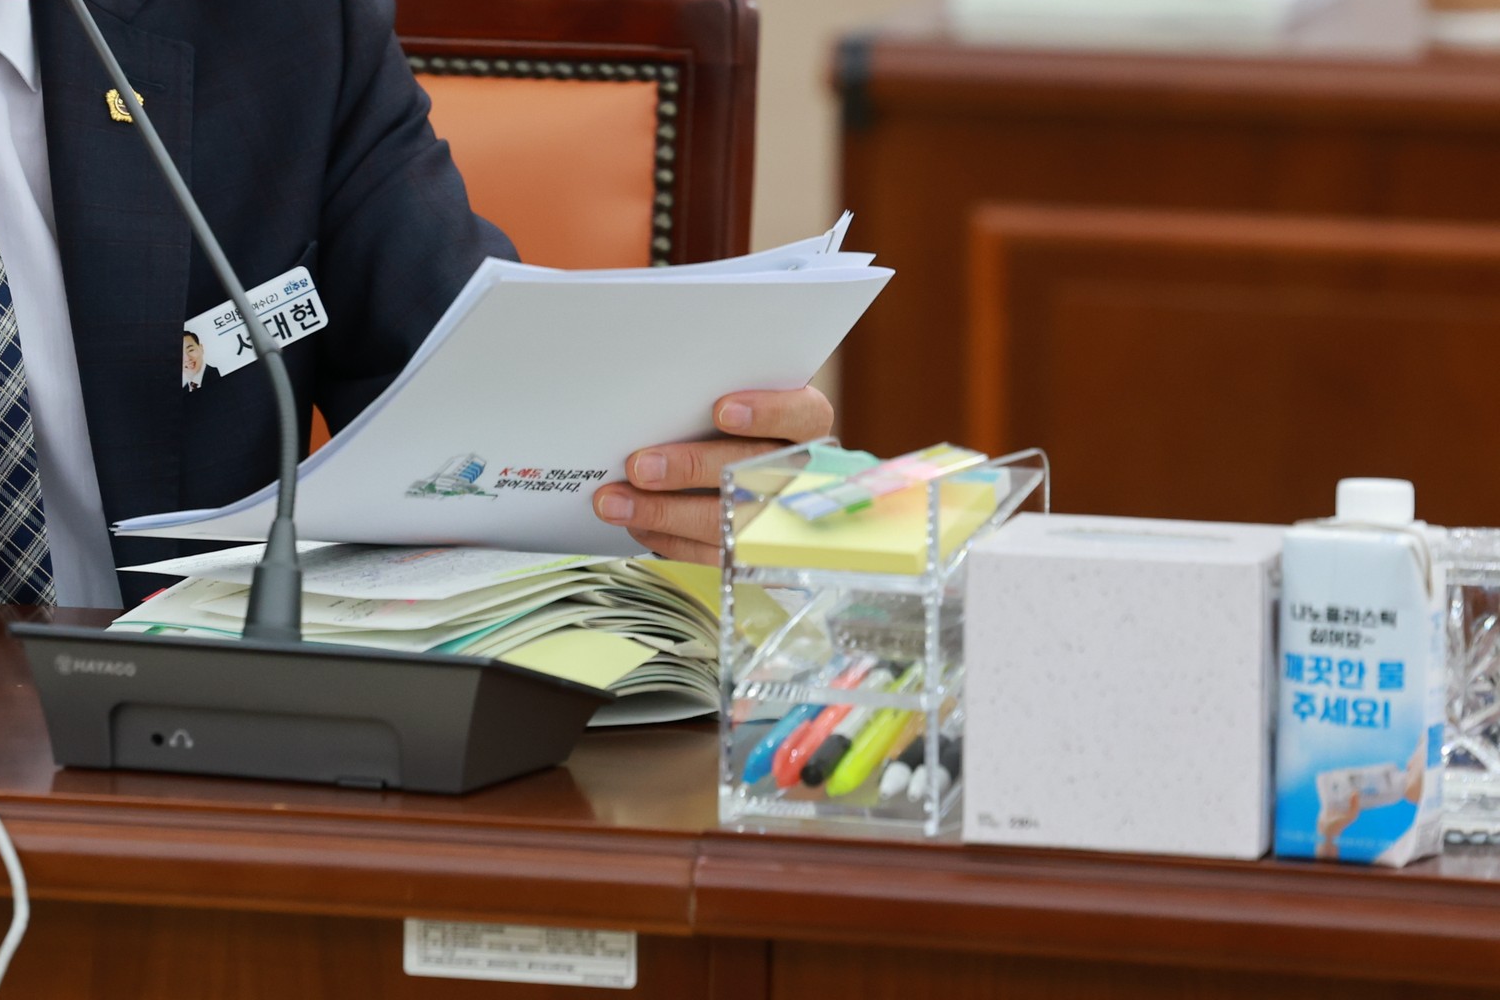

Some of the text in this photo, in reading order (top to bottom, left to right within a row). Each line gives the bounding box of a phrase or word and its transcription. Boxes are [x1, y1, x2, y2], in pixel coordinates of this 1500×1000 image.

[546, 470, 608, 480] 전남교육이
[1284, 652, 1405, 691] 깨끗한 물
[1292, 690, 1392, 729] 주세요!
